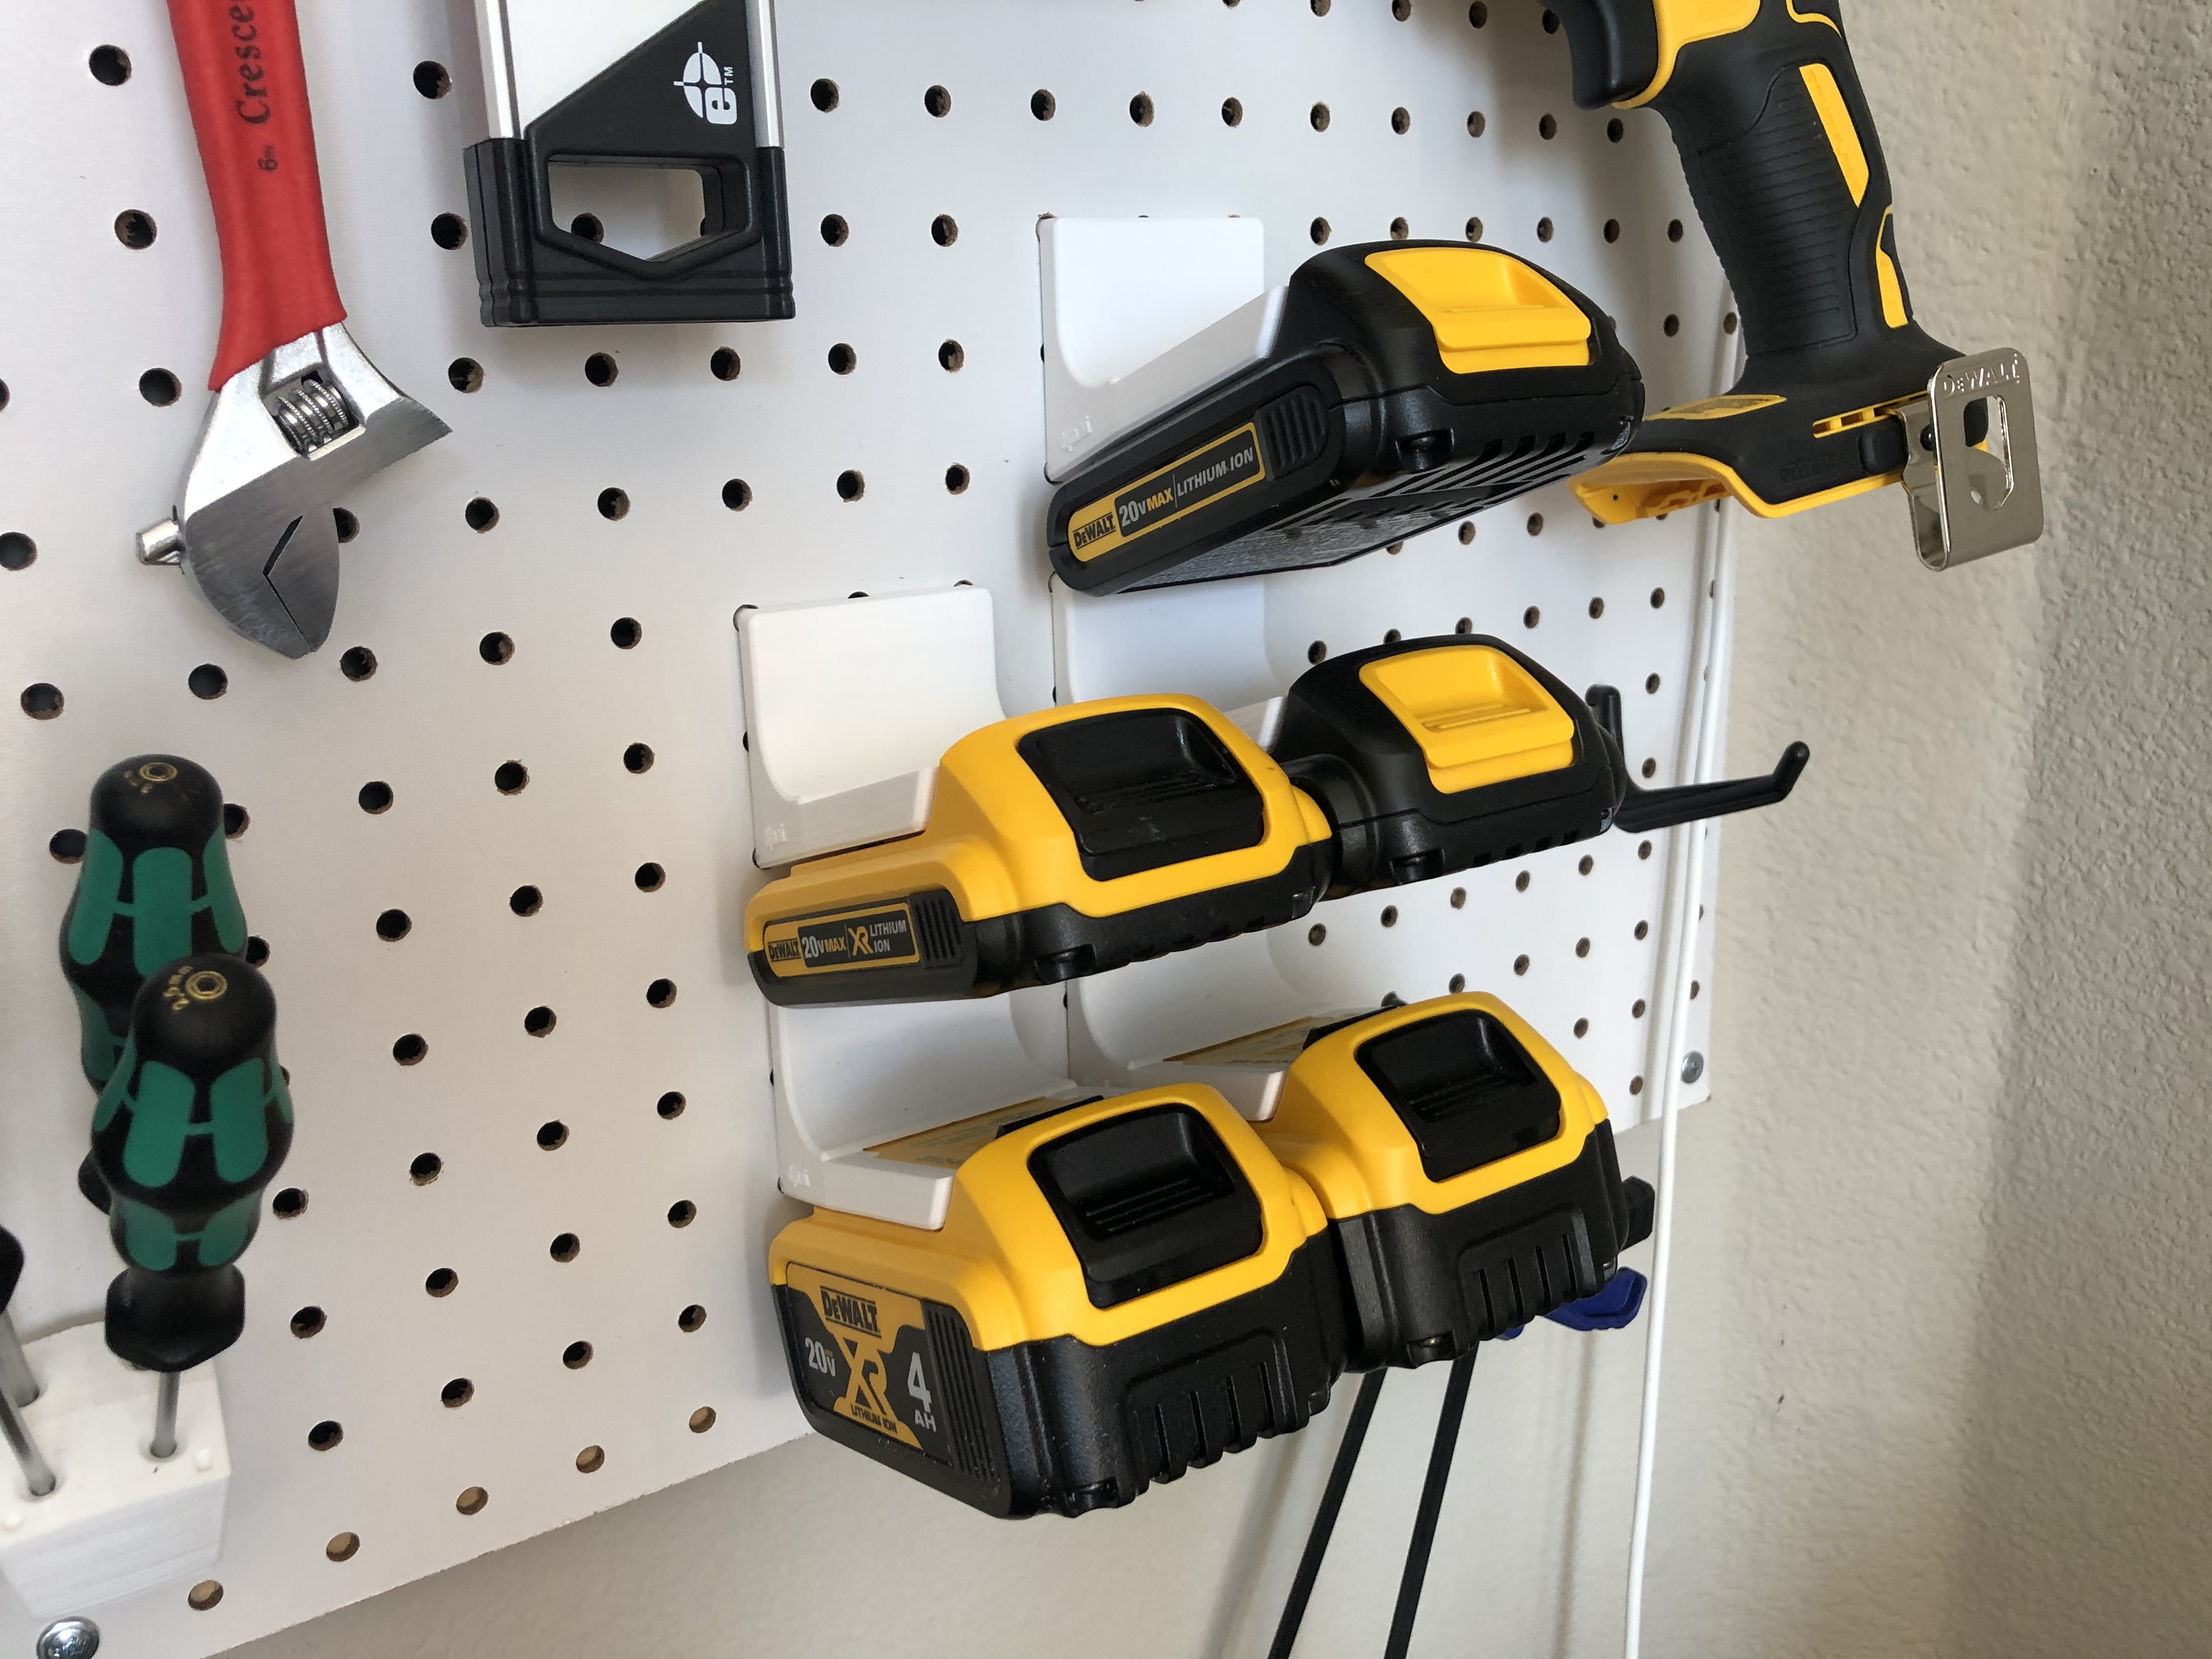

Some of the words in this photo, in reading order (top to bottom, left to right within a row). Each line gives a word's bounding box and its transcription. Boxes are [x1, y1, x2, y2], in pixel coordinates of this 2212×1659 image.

[229, 0, 272, 125] Cresce
[1177, 464, 1228, 497] LITHIUM
[1230, 447, 1254, 471] ION
[848, 926, 874, 956] XR
[870, 919, 907, 937] LITHIUM
[874, 939, 891, 953] ION
[907, 1352, 932, 1413] 4
